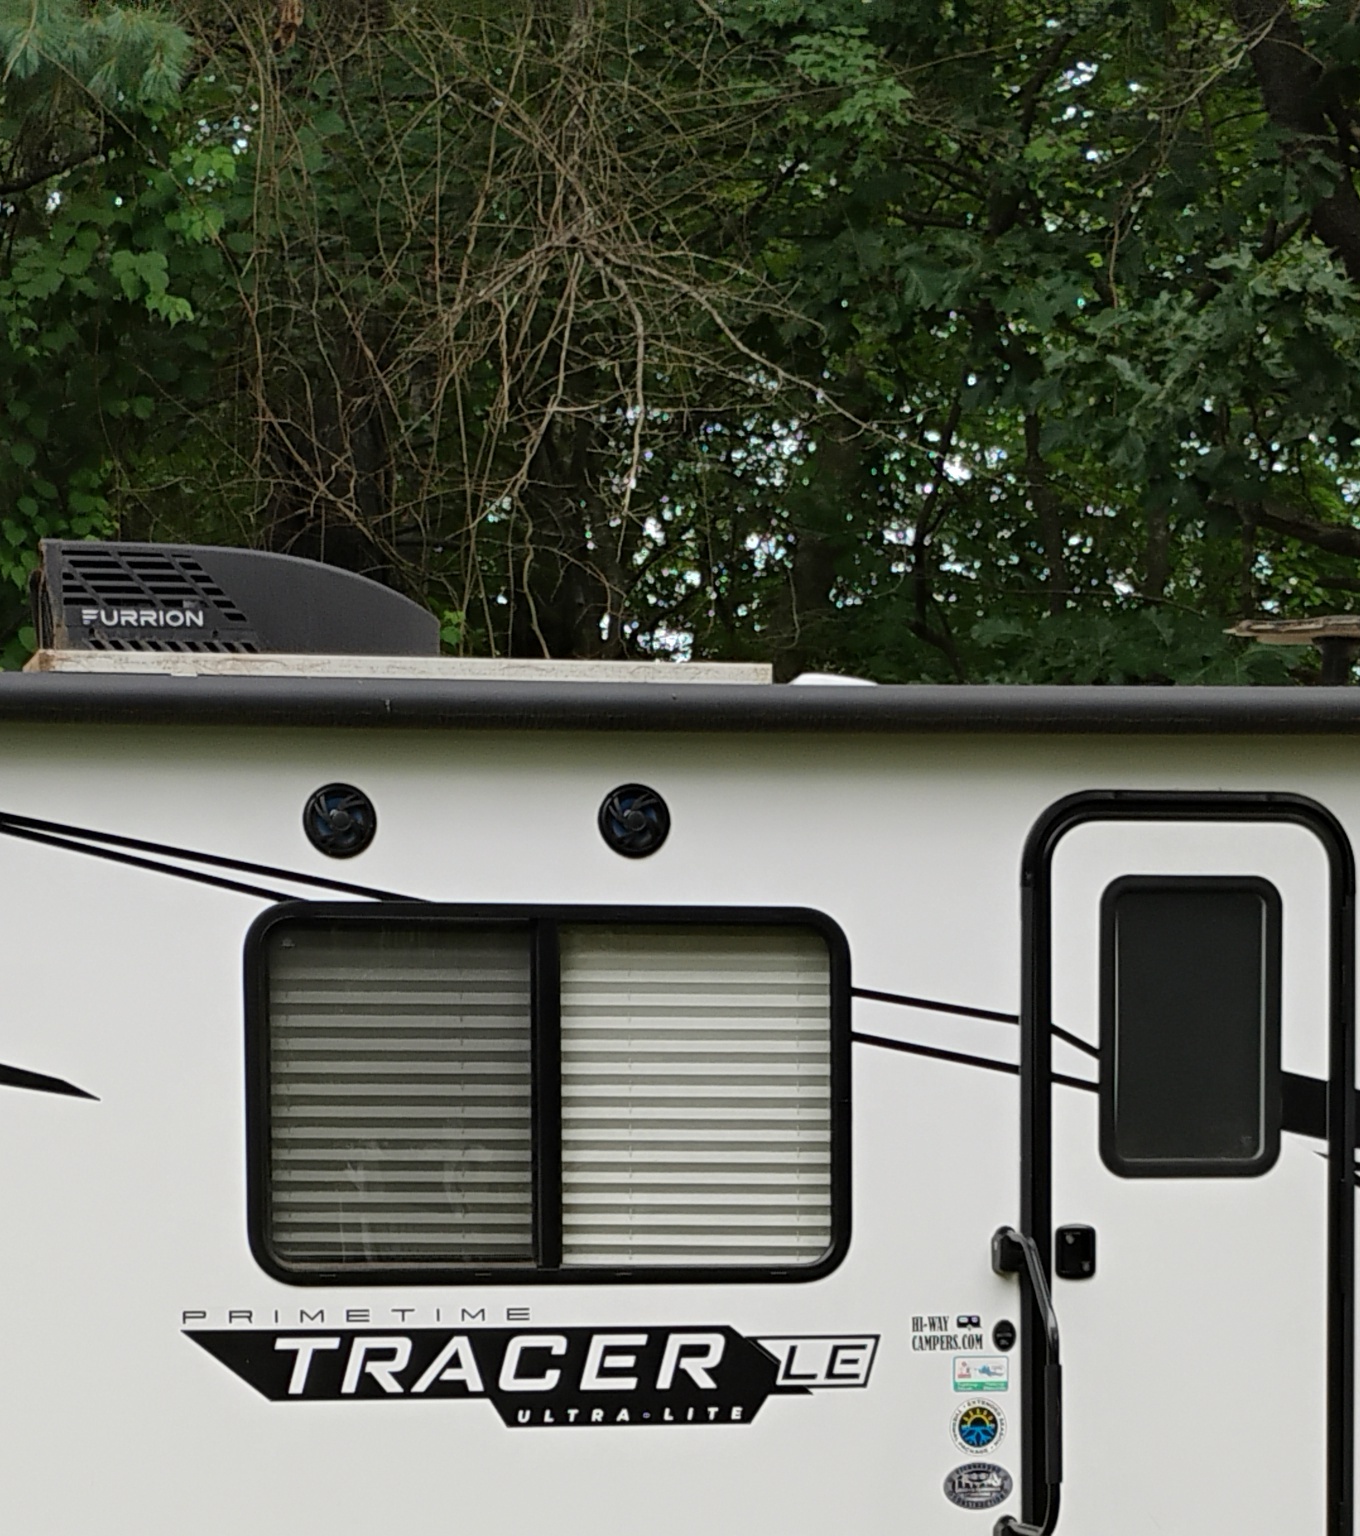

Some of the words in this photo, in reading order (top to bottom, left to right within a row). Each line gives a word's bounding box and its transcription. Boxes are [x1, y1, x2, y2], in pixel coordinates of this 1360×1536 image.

[81, 609, 204, 627] FURRION
[182, 1307, 531, 1325] PRIMETIME
[911, 1316, 950, 1332] HI-WAY
[912, 1334, 983, 1351] CAMPERS.COM
[274, 1332, 726, 1395] TRACER
[782, 1343, 868, 1380] LE
